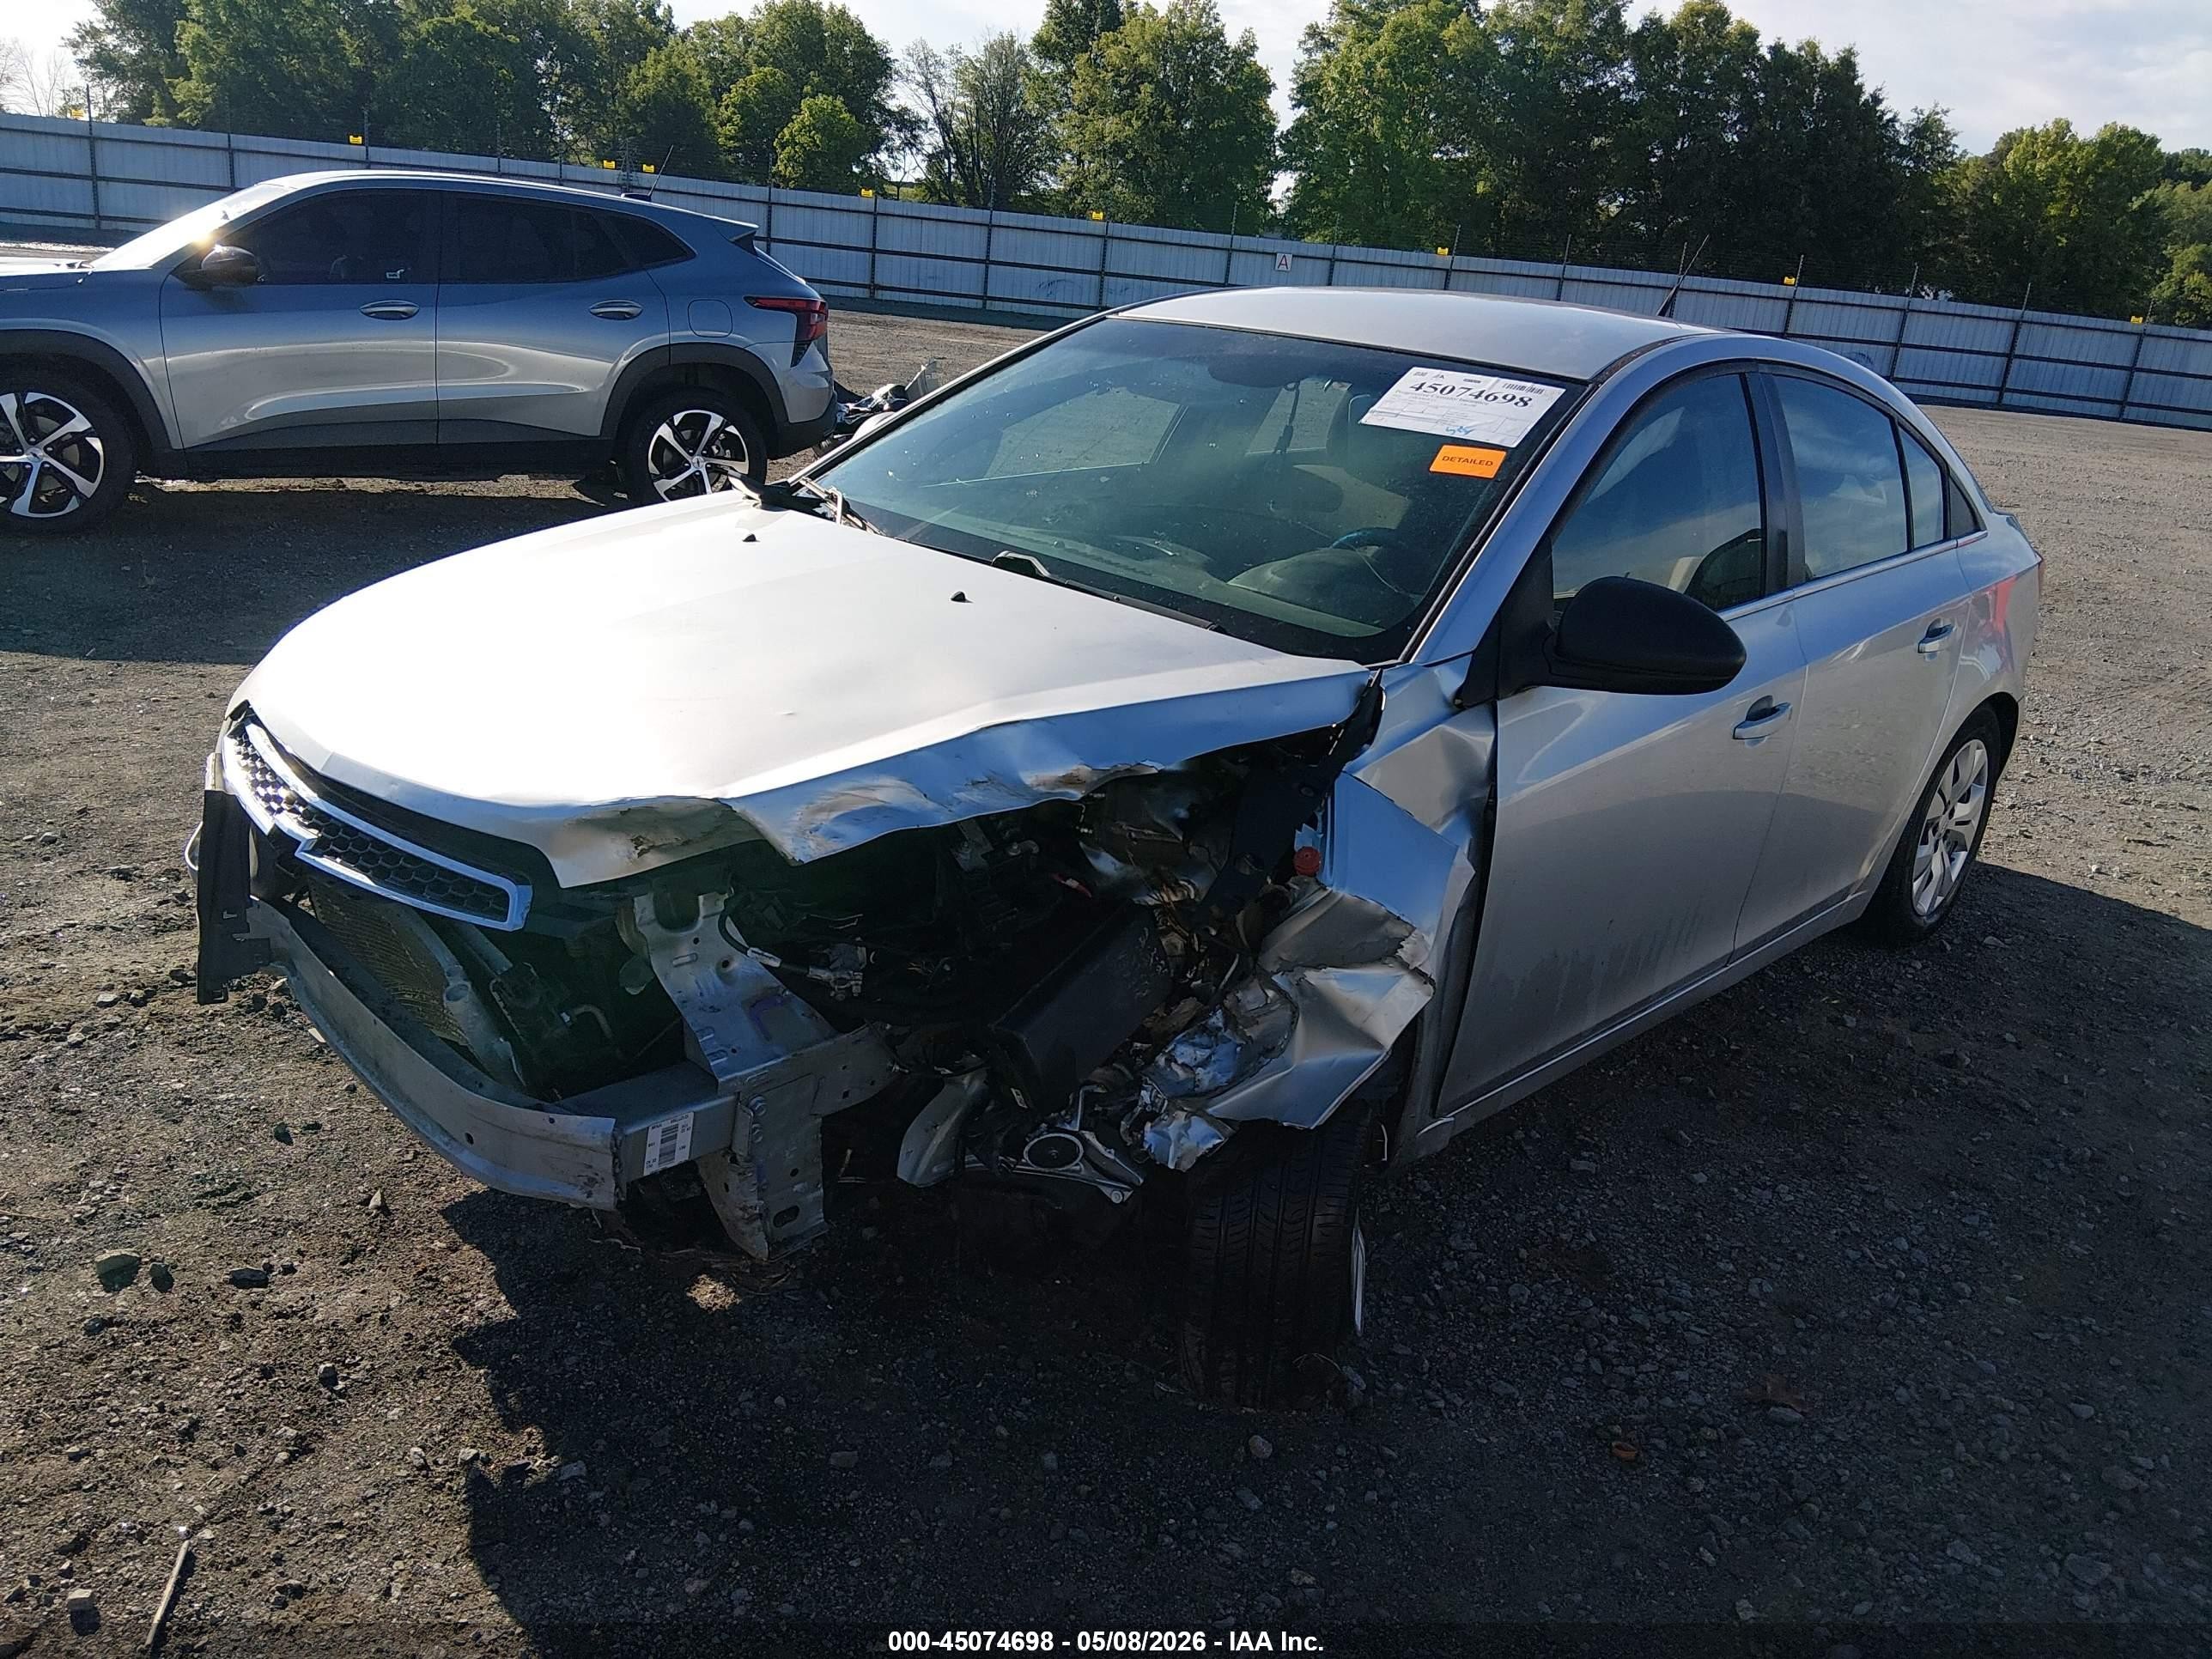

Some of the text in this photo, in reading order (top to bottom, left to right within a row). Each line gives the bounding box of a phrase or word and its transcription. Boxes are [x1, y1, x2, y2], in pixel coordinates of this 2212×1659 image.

[1277, 254, 1289, 270] A
[1409, 381, 1533, 408] 45074698
[1442, 455, 1494, 467] DETAILED
